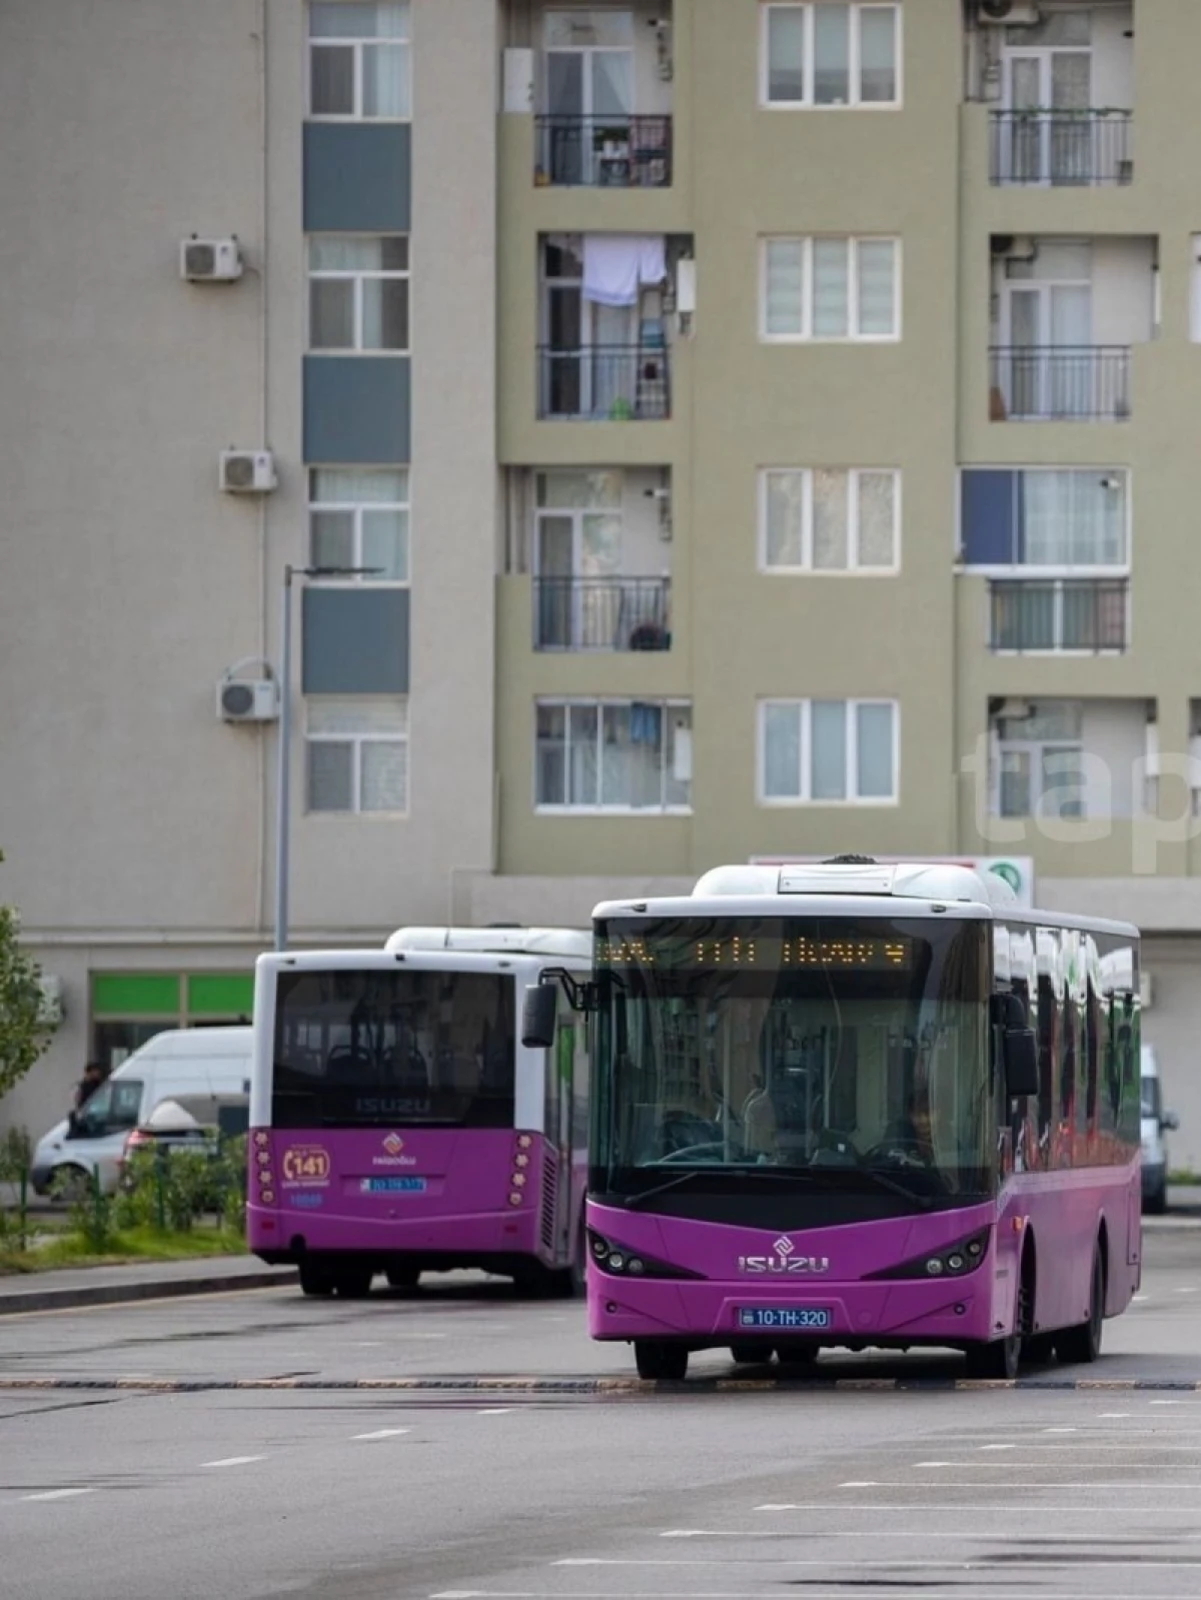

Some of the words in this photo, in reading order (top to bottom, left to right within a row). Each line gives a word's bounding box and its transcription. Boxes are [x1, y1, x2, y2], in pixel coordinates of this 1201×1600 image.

[356, 1098, 430, 1114] ISUZU
[293, 1155, 325, 1175] 141
[739, 1256, 829, 1274] ISUZU
